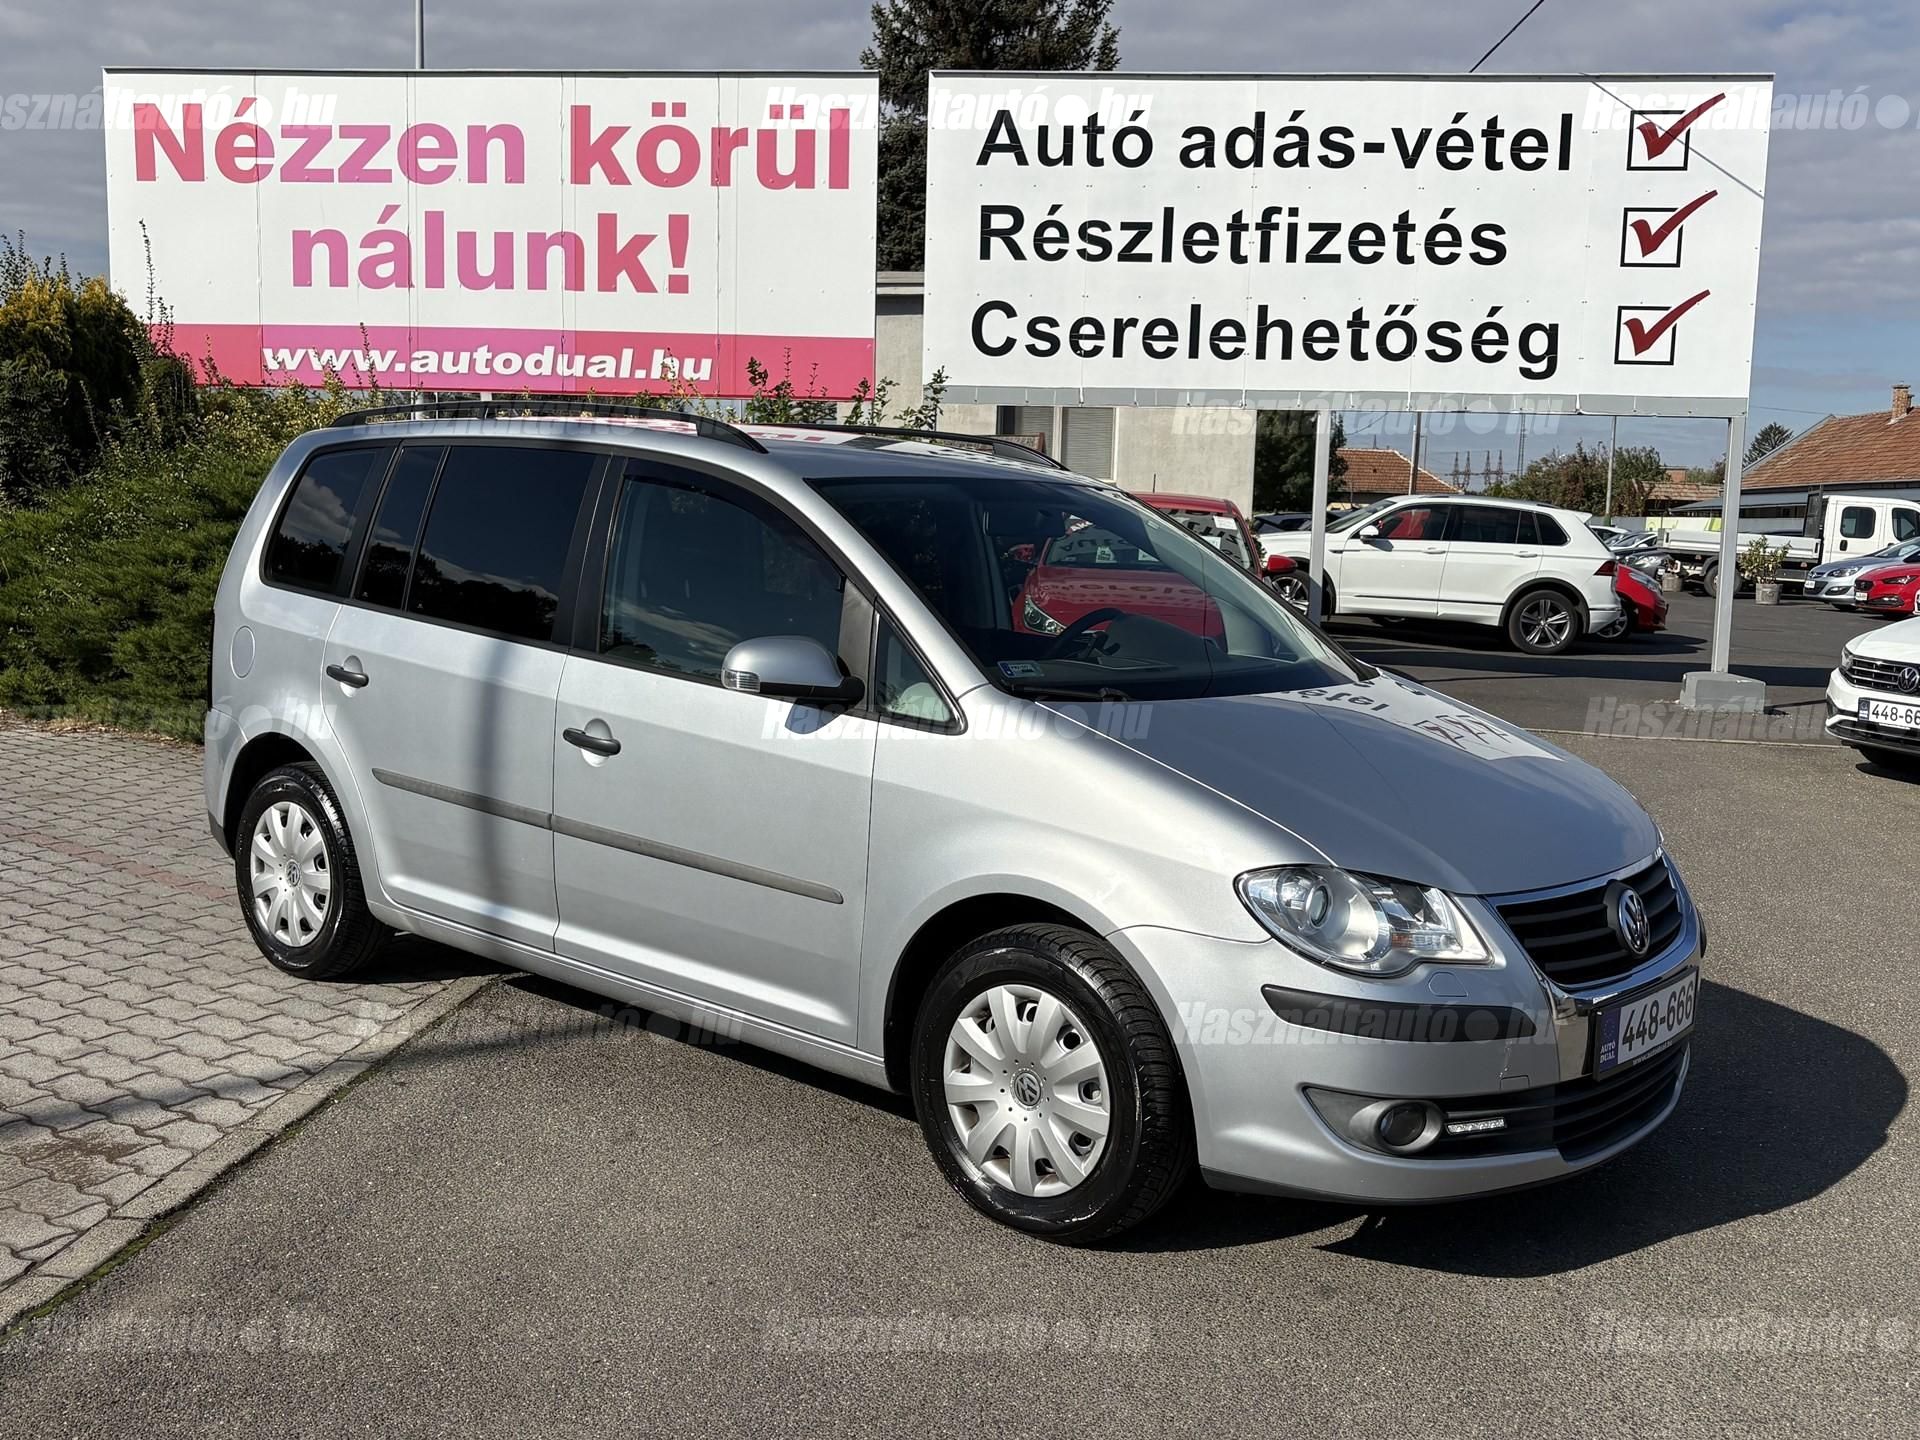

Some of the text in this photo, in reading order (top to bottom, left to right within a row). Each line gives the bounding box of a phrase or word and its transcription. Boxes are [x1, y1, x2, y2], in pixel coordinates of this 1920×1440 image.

[134, 97, 850, 190] Nézzen körül
[976, 109, 1573, 172] Autó adás-vétel
[292, 204, 690, 294] nálunk!
[979, 204, 1508, 266] Részletfizetés
[262, 346, 714, 383] www.autodual.hu
[971, 300, 1560, 380] Cserelehetőség
[1621, 980, 1694, 1052] 448-666
